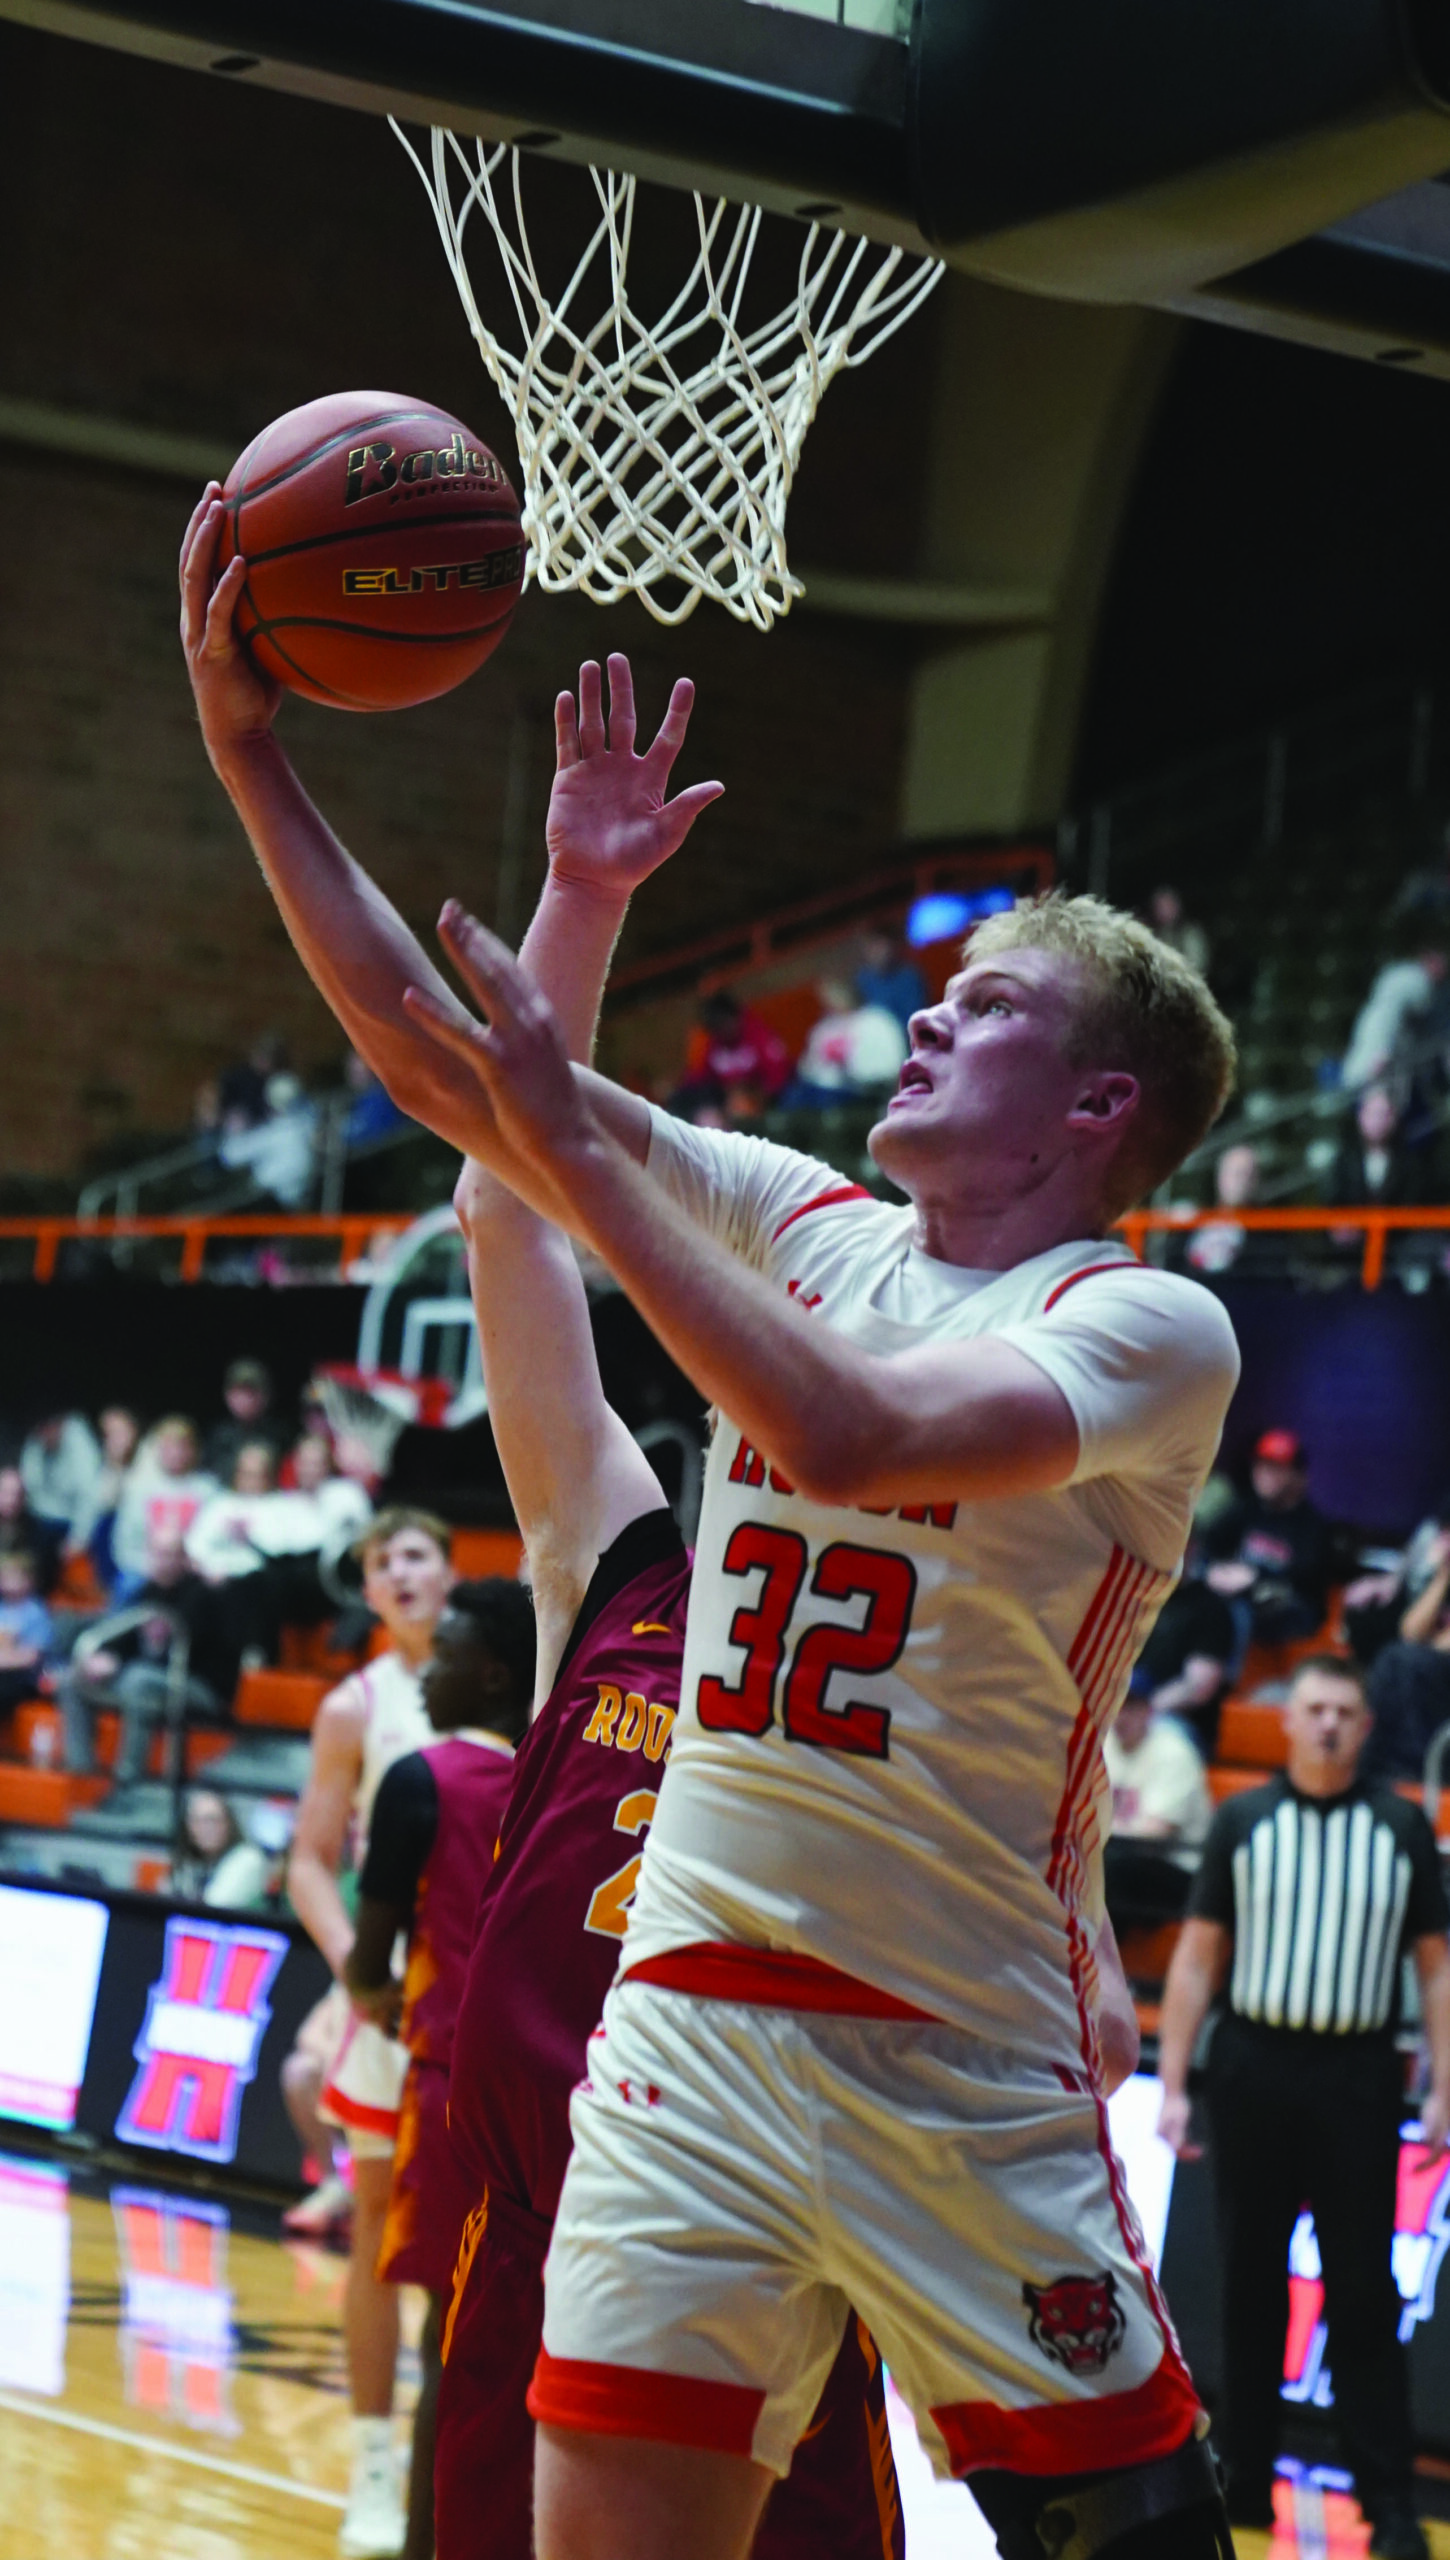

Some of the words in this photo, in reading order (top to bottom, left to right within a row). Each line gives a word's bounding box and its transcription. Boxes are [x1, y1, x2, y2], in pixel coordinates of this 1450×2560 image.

[345, 433, 507, 508] Baden
[390, 481, 499, 506] PERFECTION
[343, 559, 488, 595] ELITE
[697, 1520, 917, 1760] 32
[582, 1683, 679, 1764] ROO
